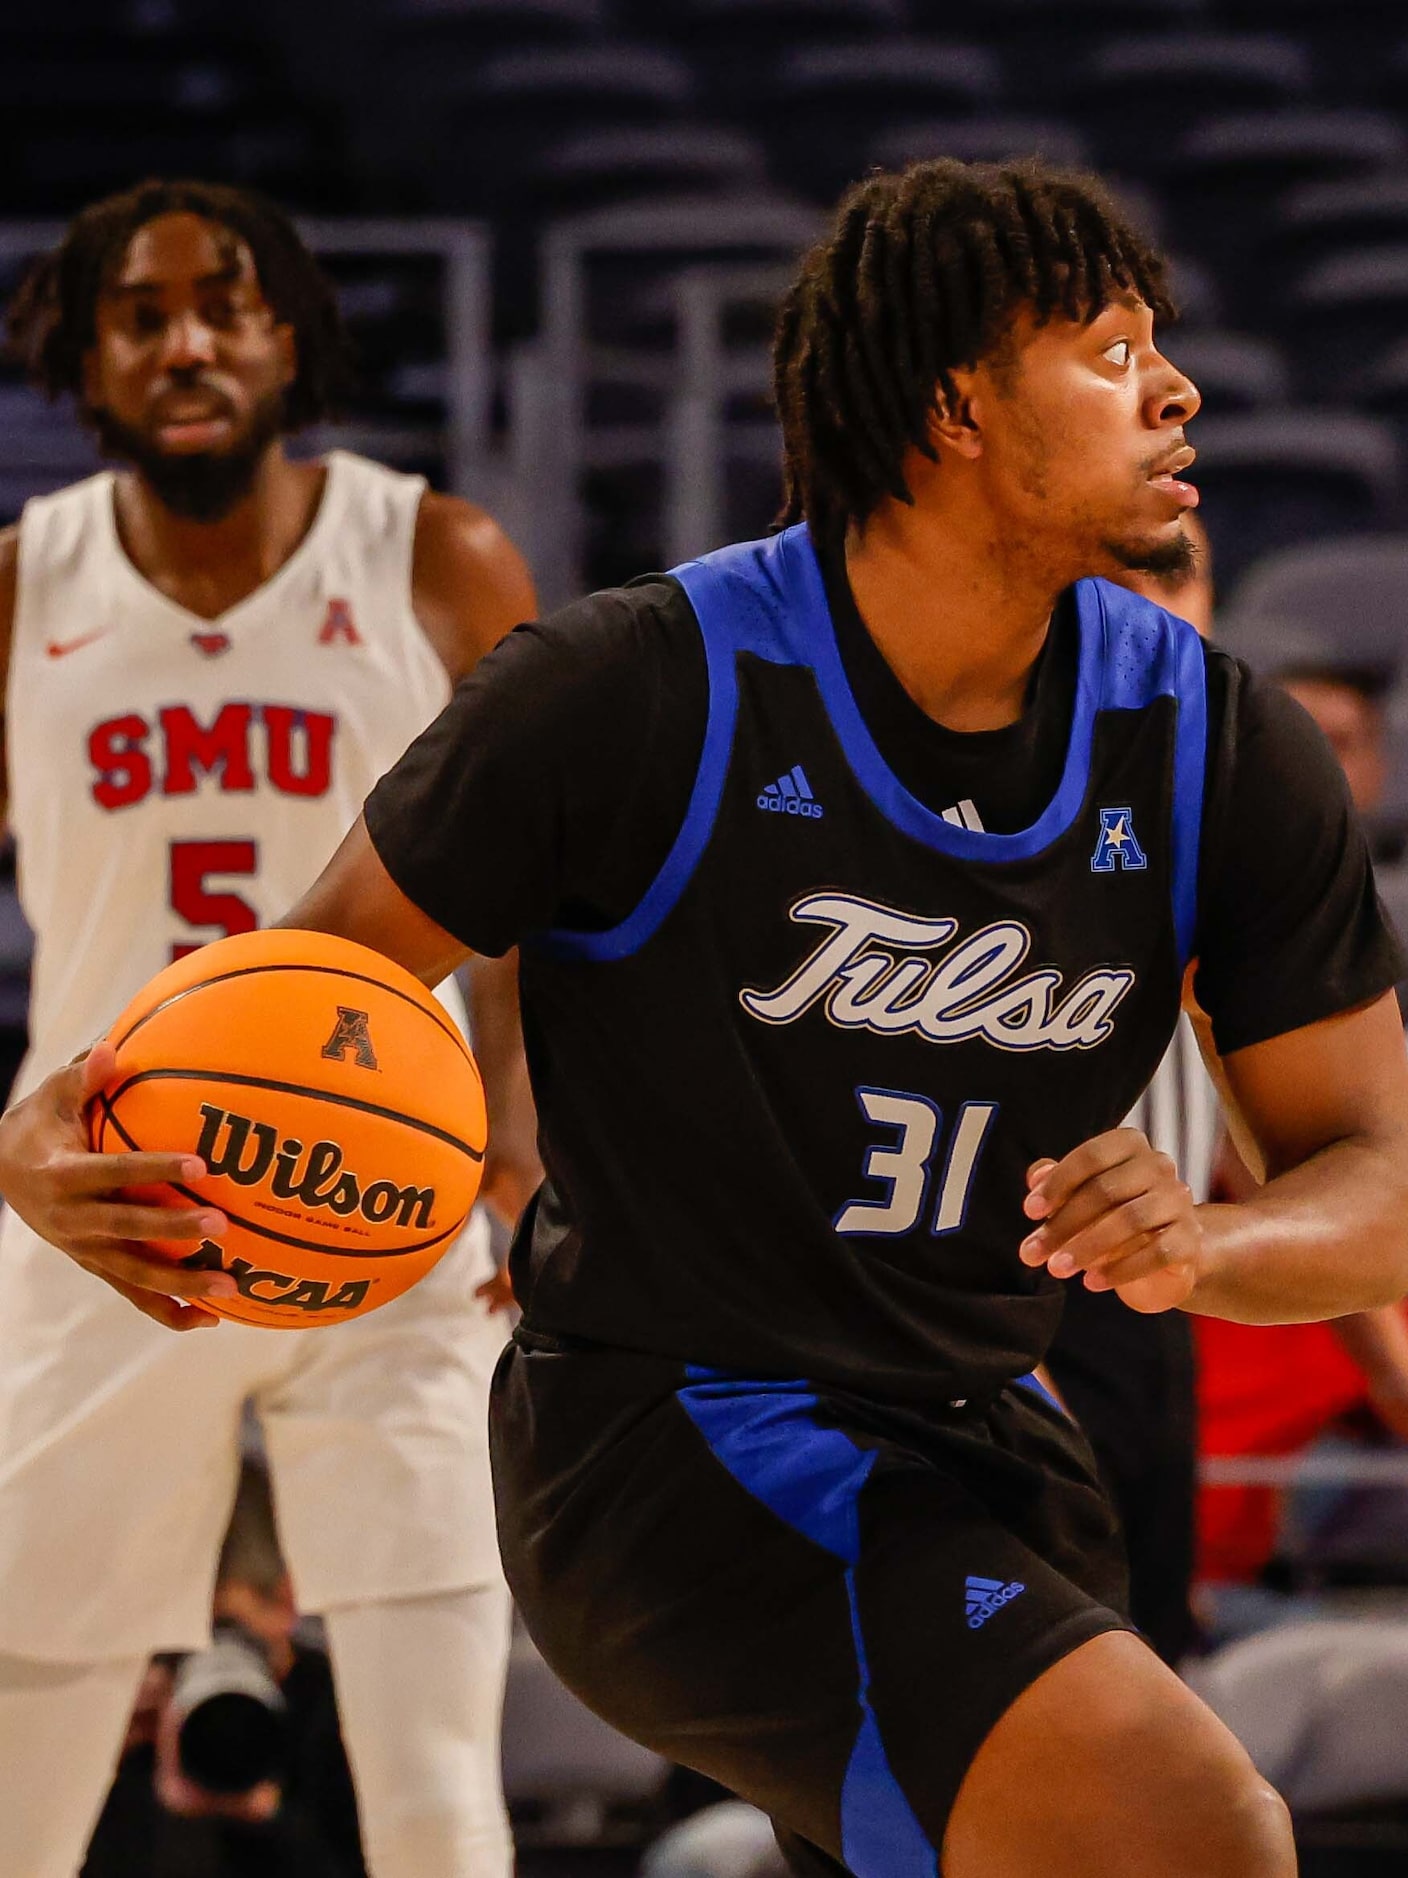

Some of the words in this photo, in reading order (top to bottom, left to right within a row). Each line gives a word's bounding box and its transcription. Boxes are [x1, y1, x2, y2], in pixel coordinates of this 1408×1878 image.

[318, 598, 361, 647] A
[87, 700, 337, 814] SMU
[757, 795, 823, 818] adidas
[1090, 807, 1147, 872] A
[169, 838, 257, 963] 5
[739, 892, 1136, 1051] Tulsa
[321, 1006, 377, 1071] A
[196, 1101, 435, 1229] Wilson
[834, 1086, 1000, 1234] 31
[968, 1582, 1025, 1629] adidas
